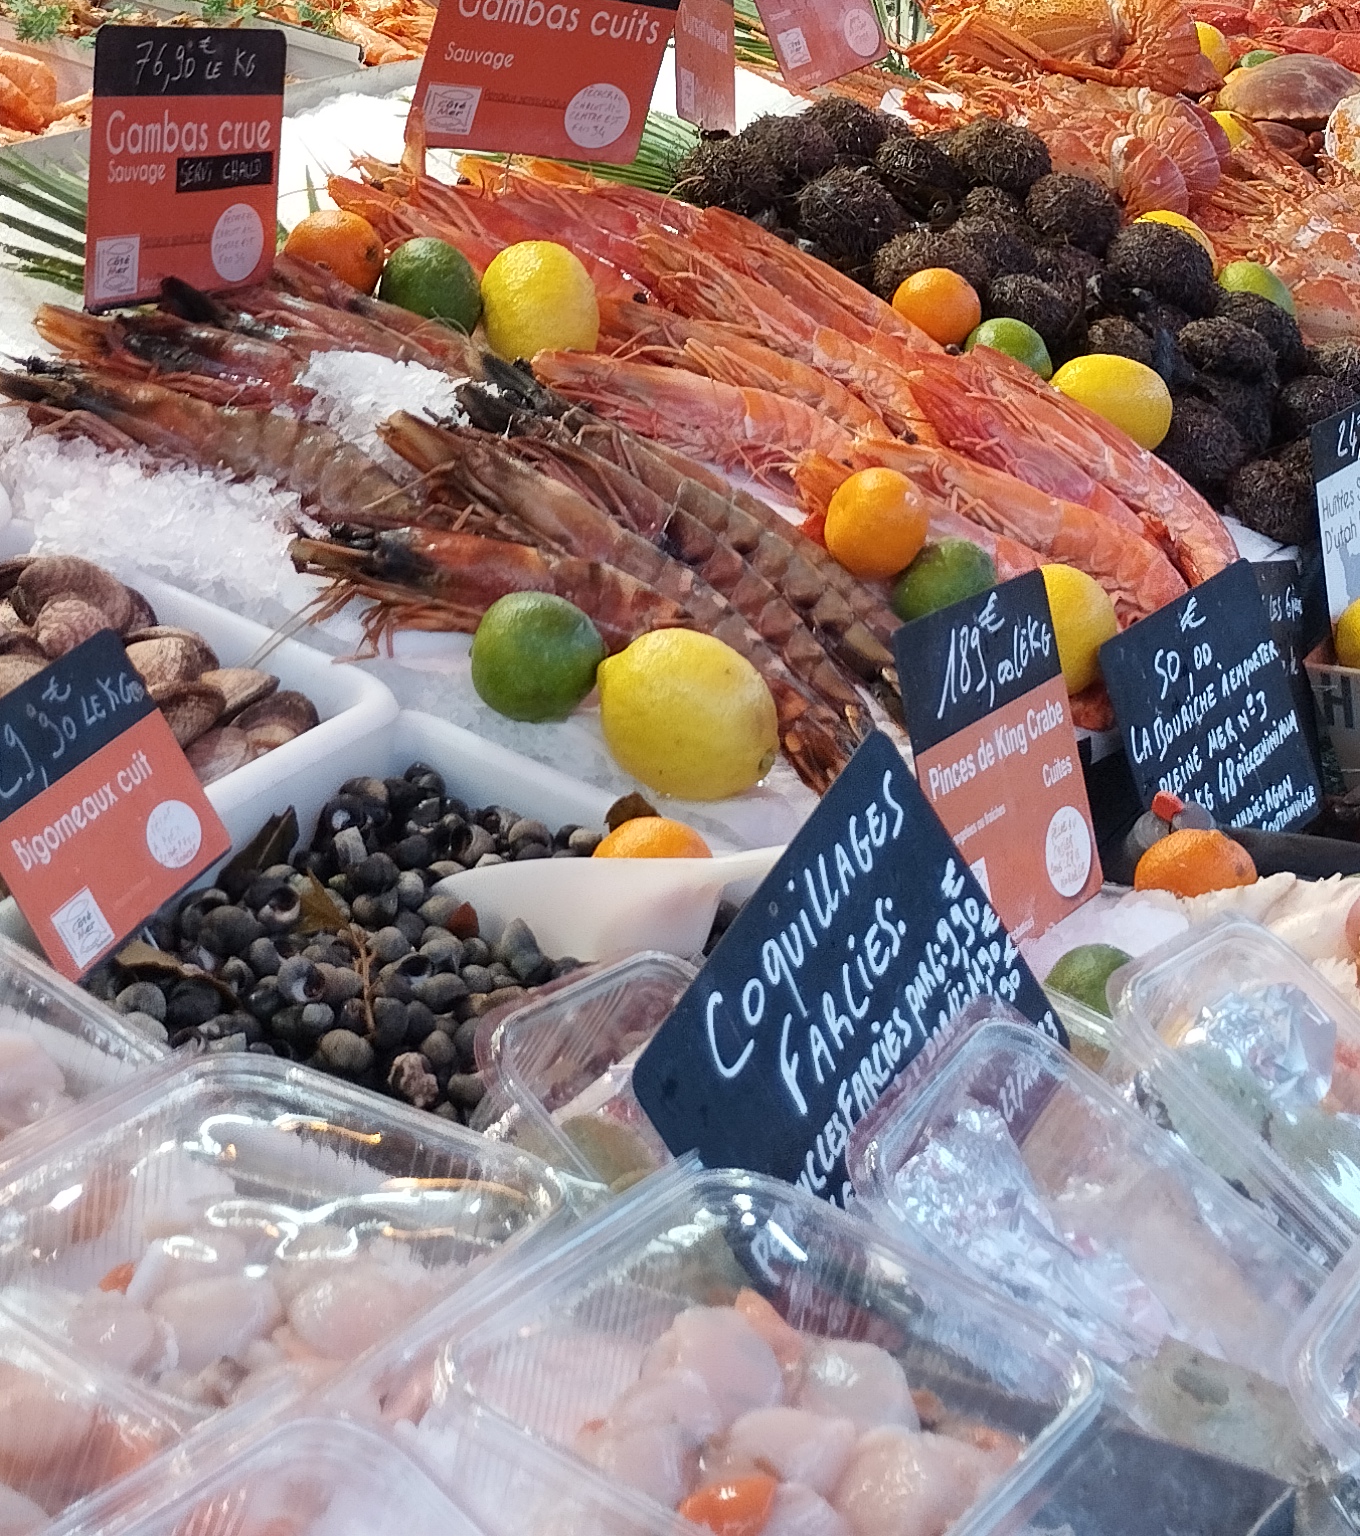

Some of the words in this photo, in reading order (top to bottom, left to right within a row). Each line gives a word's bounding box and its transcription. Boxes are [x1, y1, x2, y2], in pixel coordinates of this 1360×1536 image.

[591, 10, 661, 45] cuits
[205, 61, 222, 80] LE
[233, 48, 257, 77] KG
[444, 41, 516, 70] Sauvage
[106, 109, 209, 155] Gambas
[218, 118, 272, 150] crue
[107, 160, 167, 185] Sauvage
[1130, 724, 1152, 764] LA
[1229, 638, 1280, 692] EMPORTER
[928, 753, 976, 801] Pinces
[977, 737, 996, 772] de
[995, 721, 1030, 767] King
[1026, 698, 1065, 741] Crabe
[1042, 754, 1073, 790] Cuites
[1159, 744, 1203, 792] PLEINE
[1207, 715, 1239, 759] MER
[1217, 756, 1238, 804] 48
[10, 781, 120, 872] Bigorneaux
[116, 749, 154, 793] cuit
[706, 768, 905, 1079] COQUILLAGES
[837, 1007, 912, 1133] FARCIES
